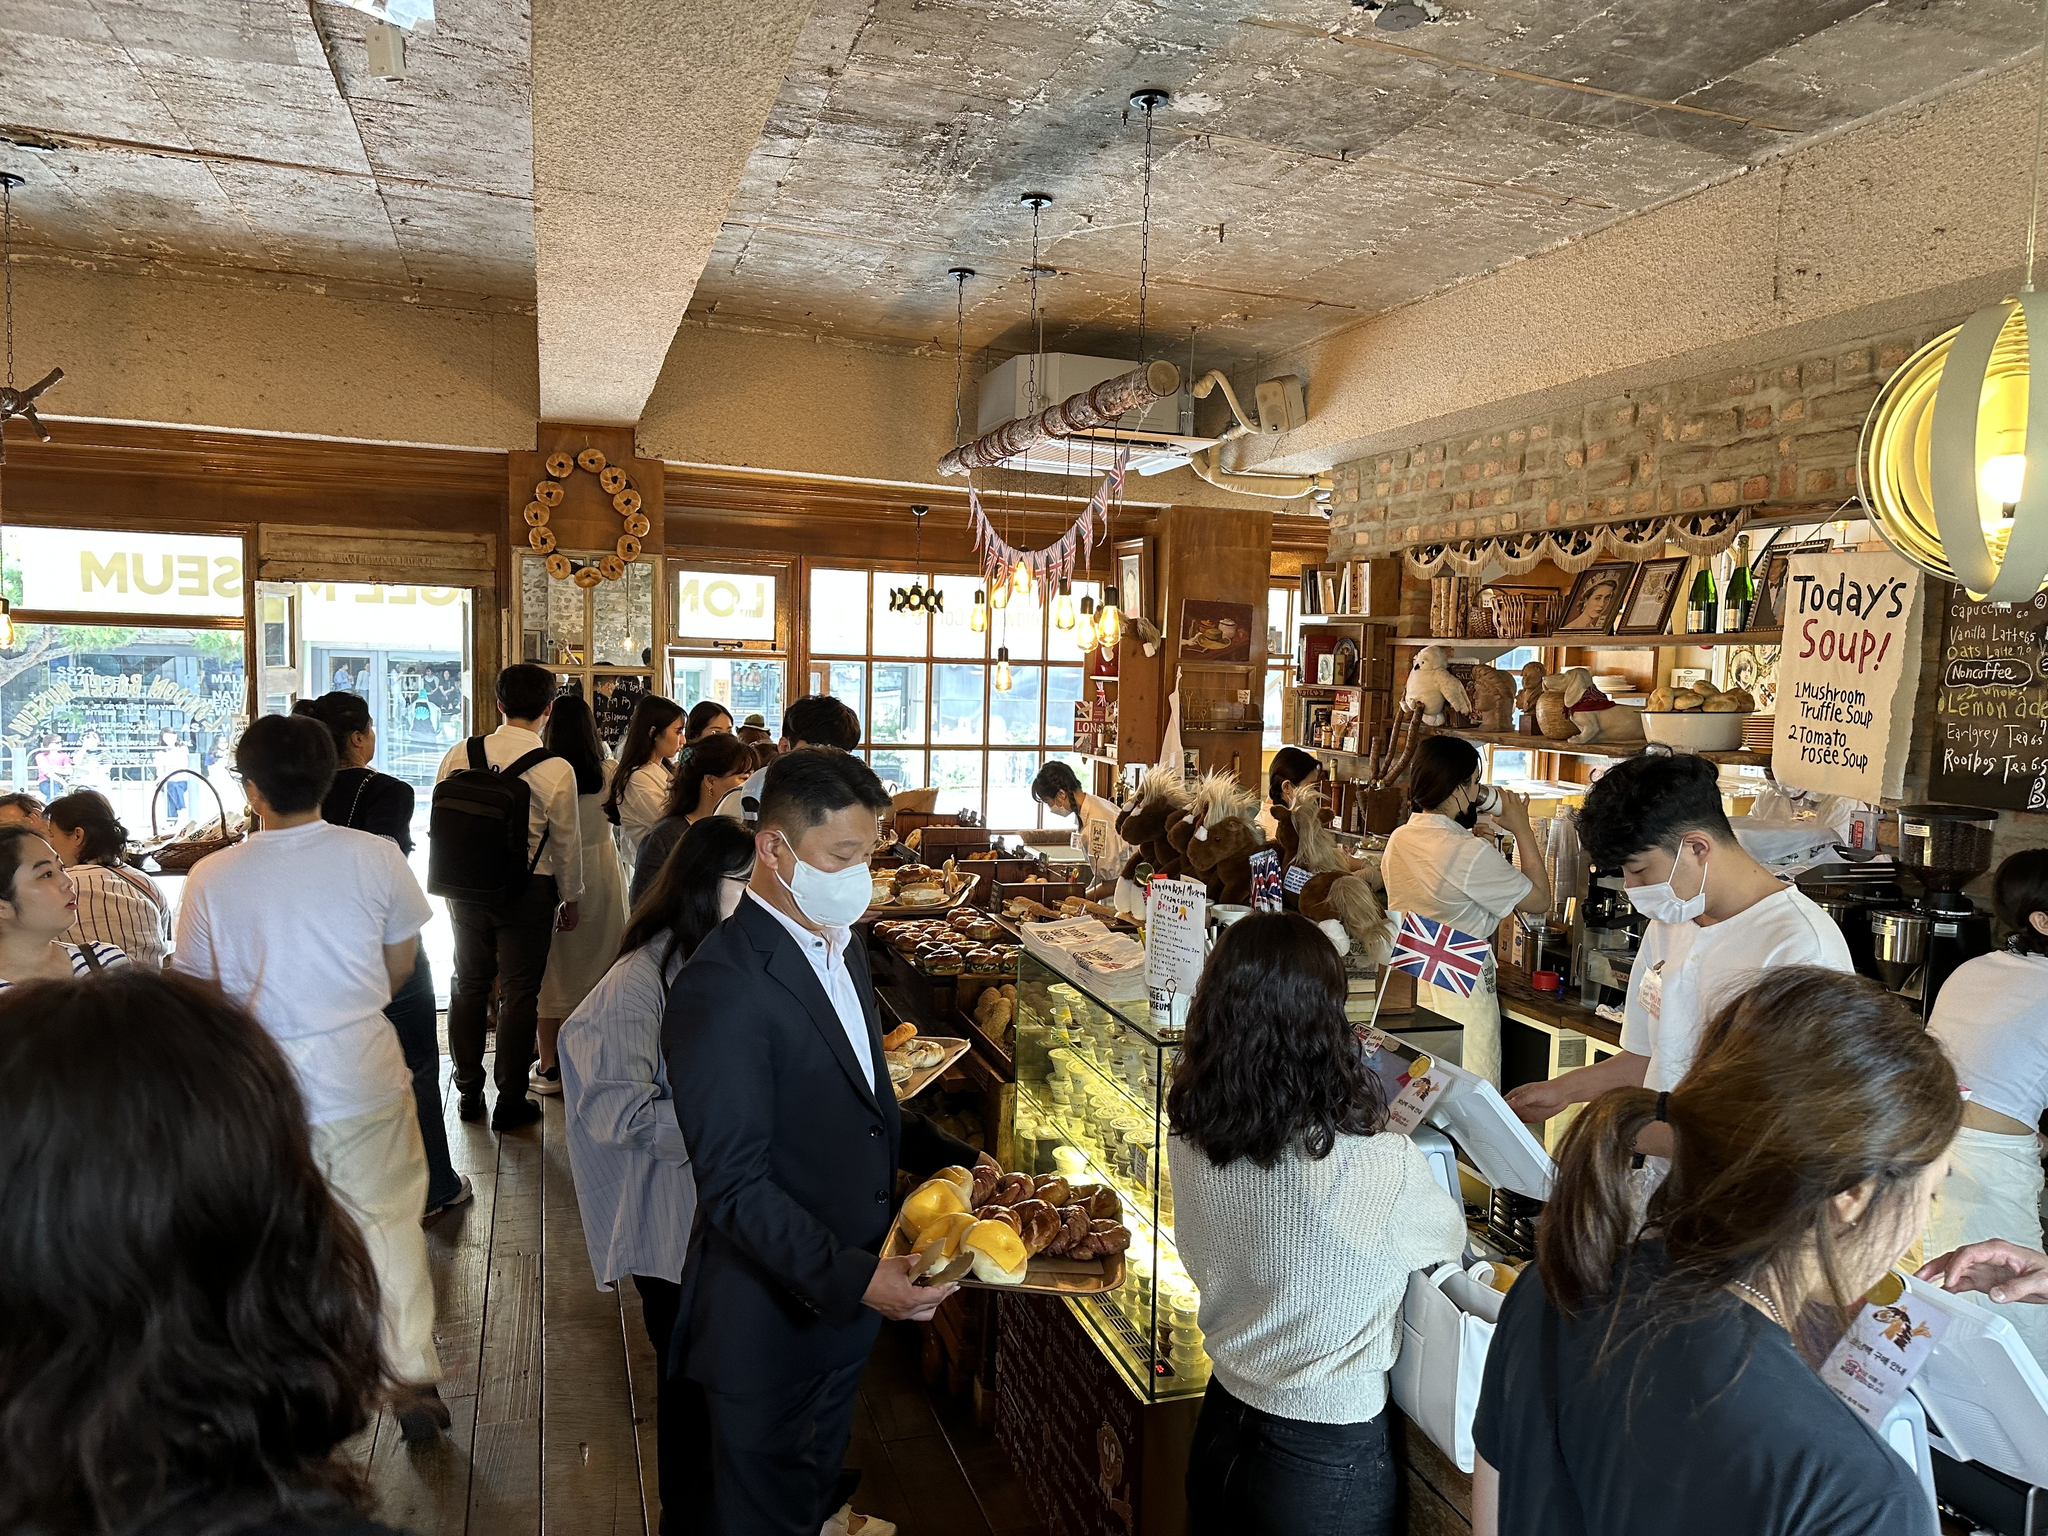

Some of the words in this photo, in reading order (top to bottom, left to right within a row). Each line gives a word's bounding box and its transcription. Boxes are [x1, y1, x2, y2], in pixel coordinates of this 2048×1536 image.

[1793, 572, 1907, 620] Today's
[1799, 618, 1891, 674] Soup!
[1950, 624, 1986, 645] Vanilla
[1992, 624, 2024, 642] Latte
[1947, 645, 1980, 660] Oats
[57, 666, 94, 676] SS23
[1952, 662, 2017, 680] Noncoffee
[1801, 701, 1843, 722] Truffle
[1846, 705, 1873, 729] Soup
[1948, 691, 2007, 719] Lemon
[1799, 726, 1847, 747] Tomato
[1948, 723, 1998, 748] Earlgrey
[2003, 725, 2028, 748] Tea
[1841, 748, 1868, 774] Soup
[2002, 755, 2026, 784] Tea
[1889, 1361, 1907, 1376] 안내
